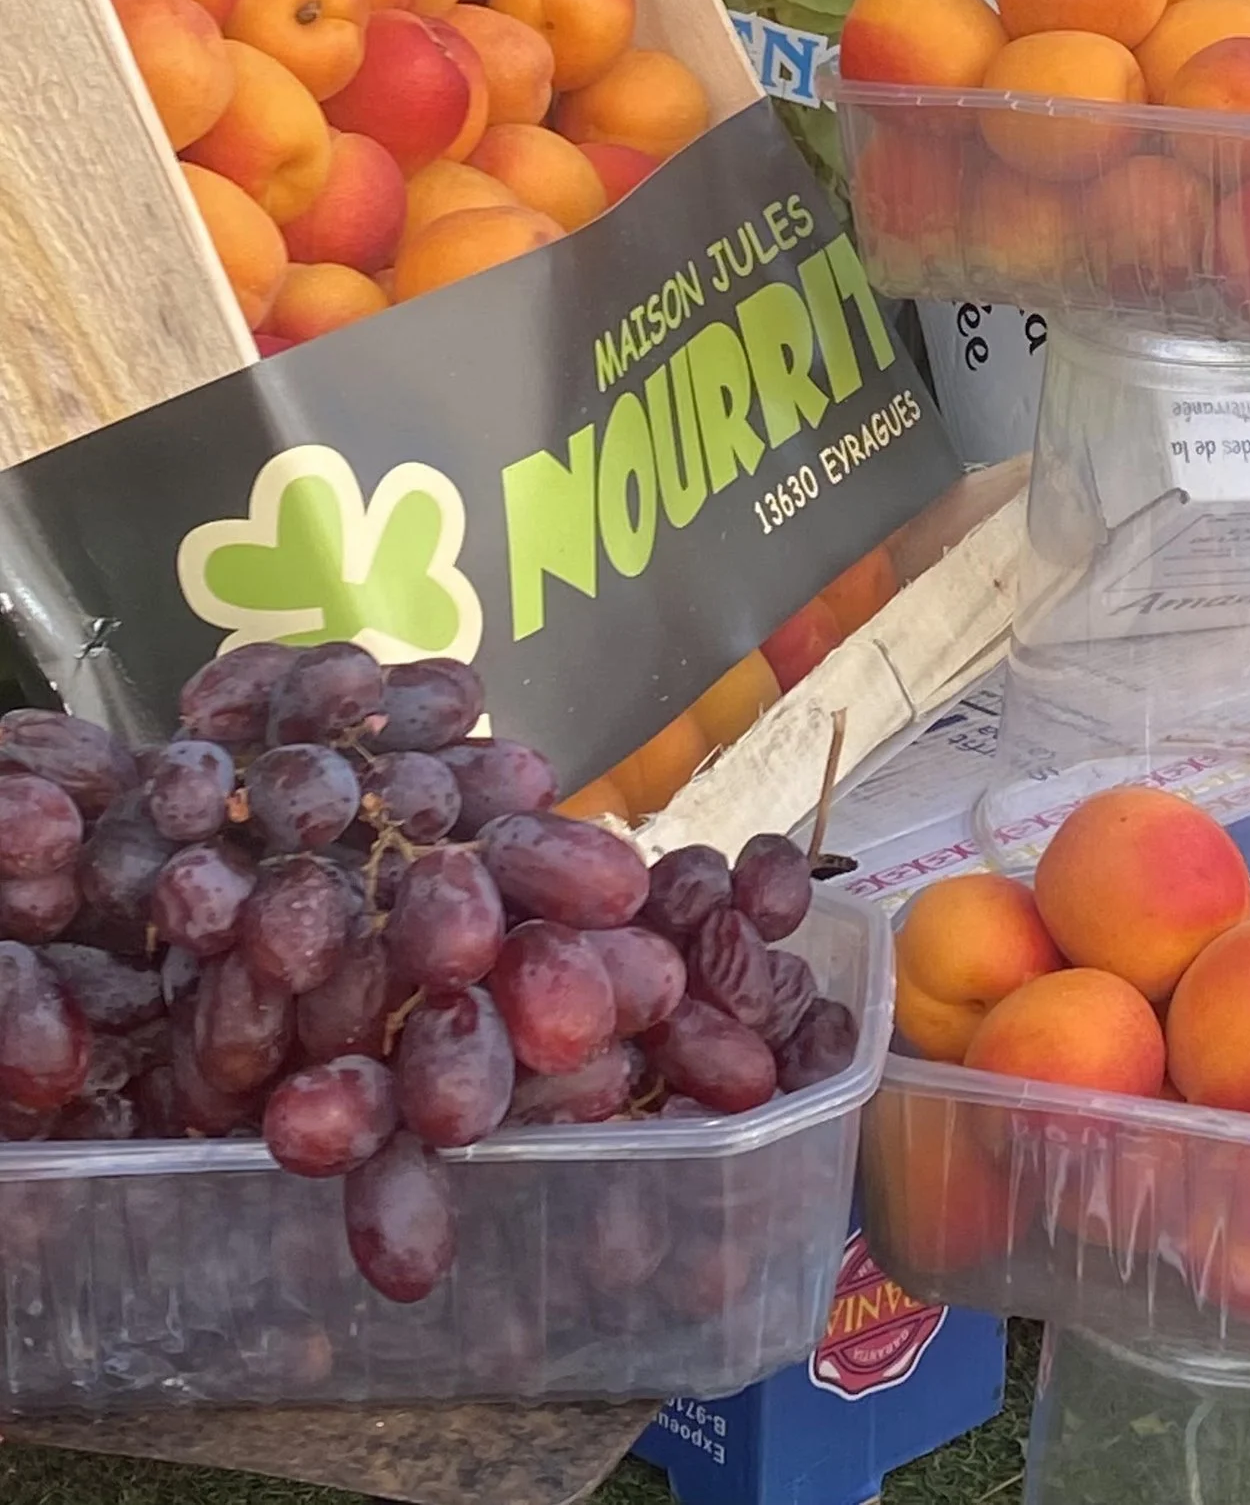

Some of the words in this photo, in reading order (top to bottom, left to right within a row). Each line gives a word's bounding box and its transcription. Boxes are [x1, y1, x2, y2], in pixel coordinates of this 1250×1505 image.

[594, 260, 705, 392] MAISON
[706, 194, 814, 292] JULES
[754, 465, 819, 535] 13630
[819, 389, 921, 485] EYRAGUES
[1172, 441, 1190, 463] la
[1195, 439, 1217, 463] de
[655, 1411, 725, 1465] Expoeu
